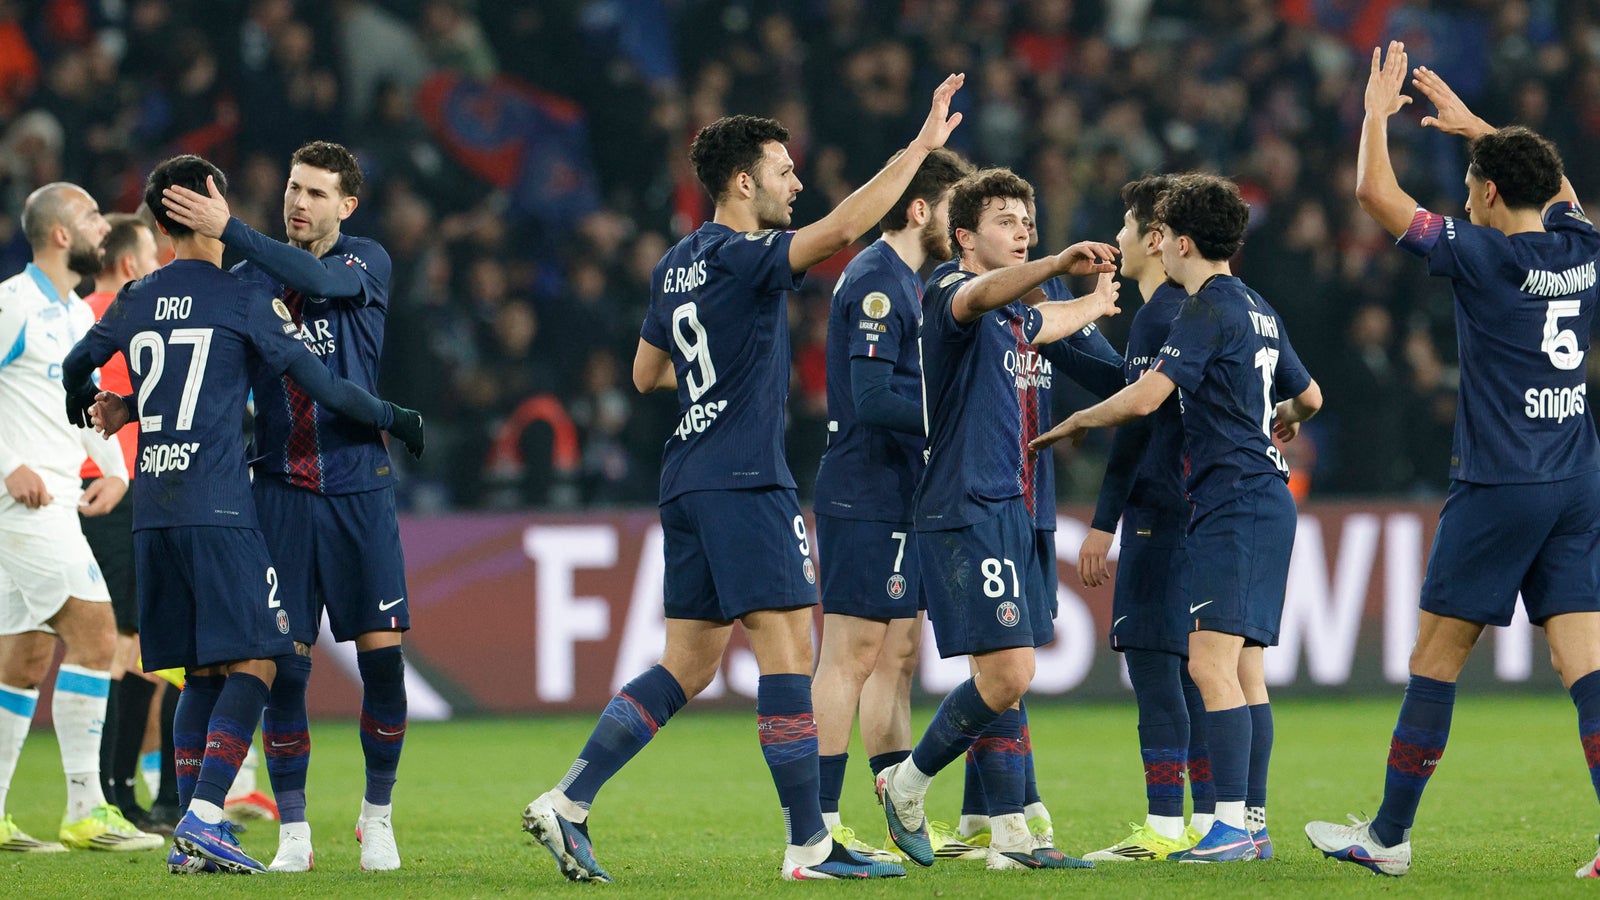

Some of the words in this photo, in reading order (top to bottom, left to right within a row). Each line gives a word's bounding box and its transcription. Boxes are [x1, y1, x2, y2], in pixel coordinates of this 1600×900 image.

[154, 295, 193, 321] DRO
[672, 301, 717, 403] 9
[1541, 299, 1585, 371] 5
[129, 328, 214, 433] 27
[793, 514, 810, 557] 9
[891, 531, 907, 573] 7
[266, 566, 281, 609] 2
